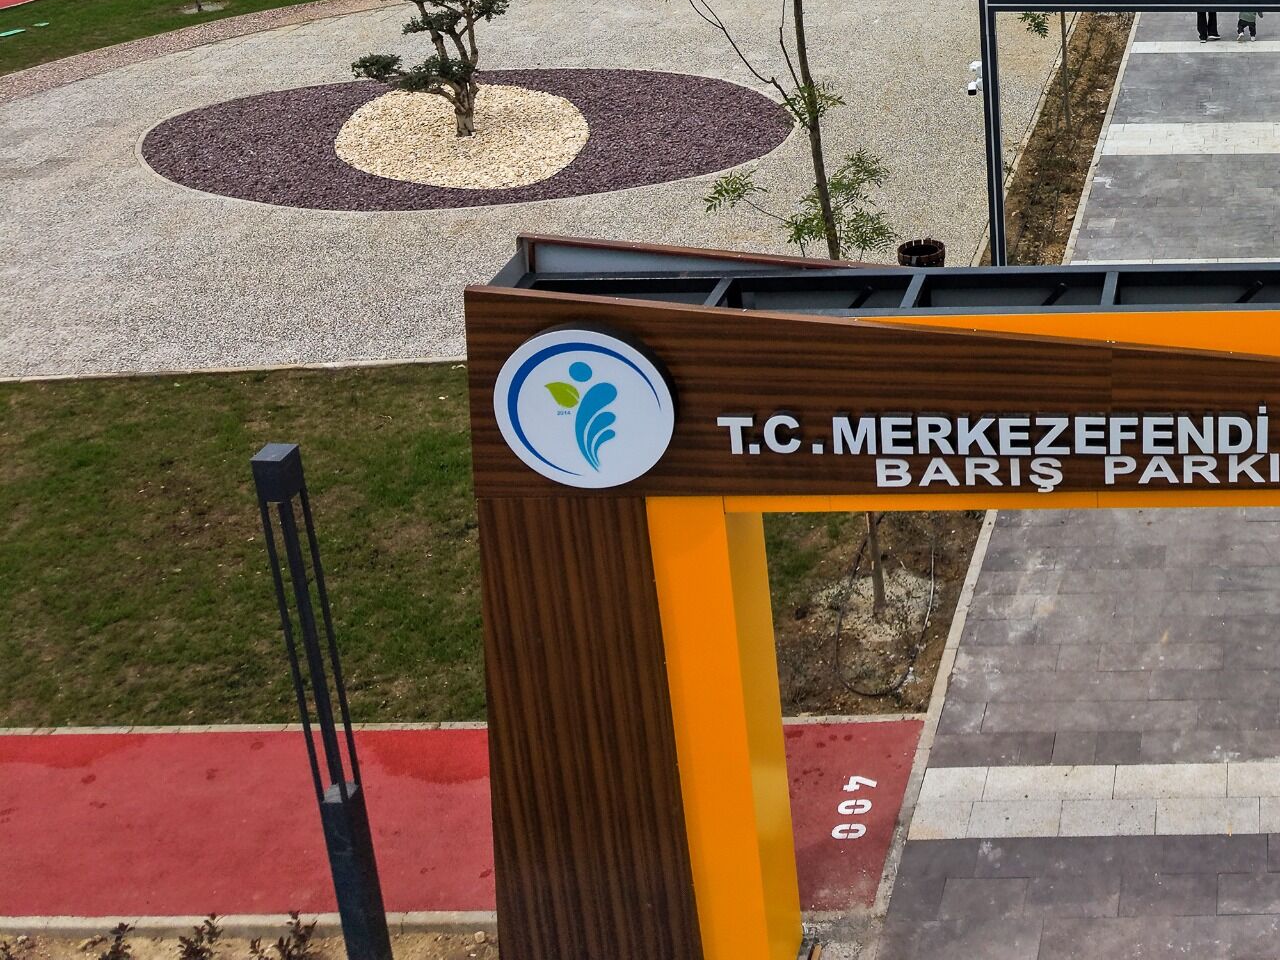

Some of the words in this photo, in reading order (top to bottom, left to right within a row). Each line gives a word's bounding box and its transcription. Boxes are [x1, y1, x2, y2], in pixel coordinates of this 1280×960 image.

[875, 456, 1064, 493] BARIŞ
[1104, 452, 1280, 485] PARKI
[831, 775, 878, 840] 400
